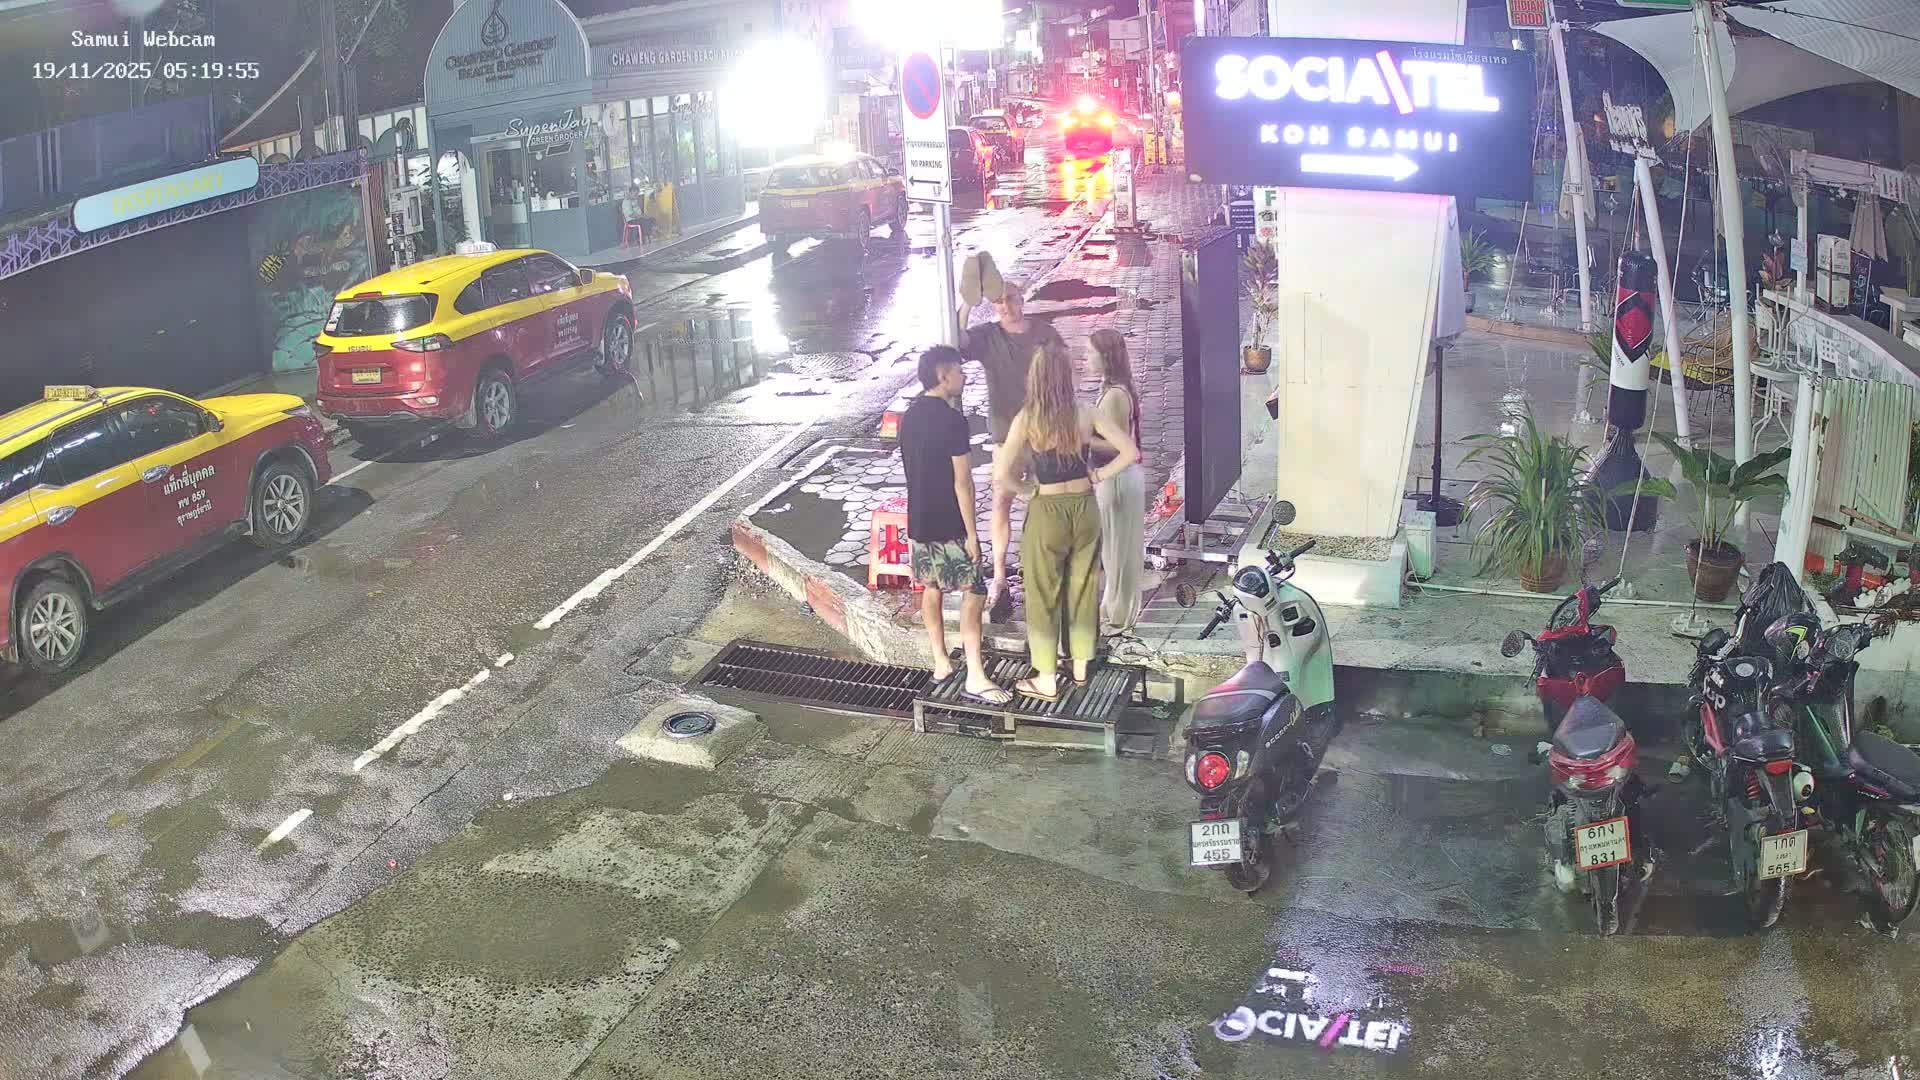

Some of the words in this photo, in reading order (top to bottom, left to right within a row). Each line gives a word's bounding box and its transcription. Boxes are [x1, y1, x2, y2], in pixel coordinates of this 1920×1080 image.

[1513, 12, 1544, 25] FOOD
[612, 51, 656, 66] CHAWENG
[659, 50, 692, 64] GARDEN
[1259, 123, 1330, 146] KOH
[1346, 126, 1459, 153] SAMUI
[910, 159, 919, 168] NO
[919, 159, 943, 169] PARKING
[112, 171, 225, 216] DISPENSARY
[191, 489, 206, 503] 859
[1202, 823, 1230, 837] 2กถ
[1587, 823, 1615, 839] 6กง
[1203, 848, 1231, 862] 455
[1591, 850, 1616, 866] 831
